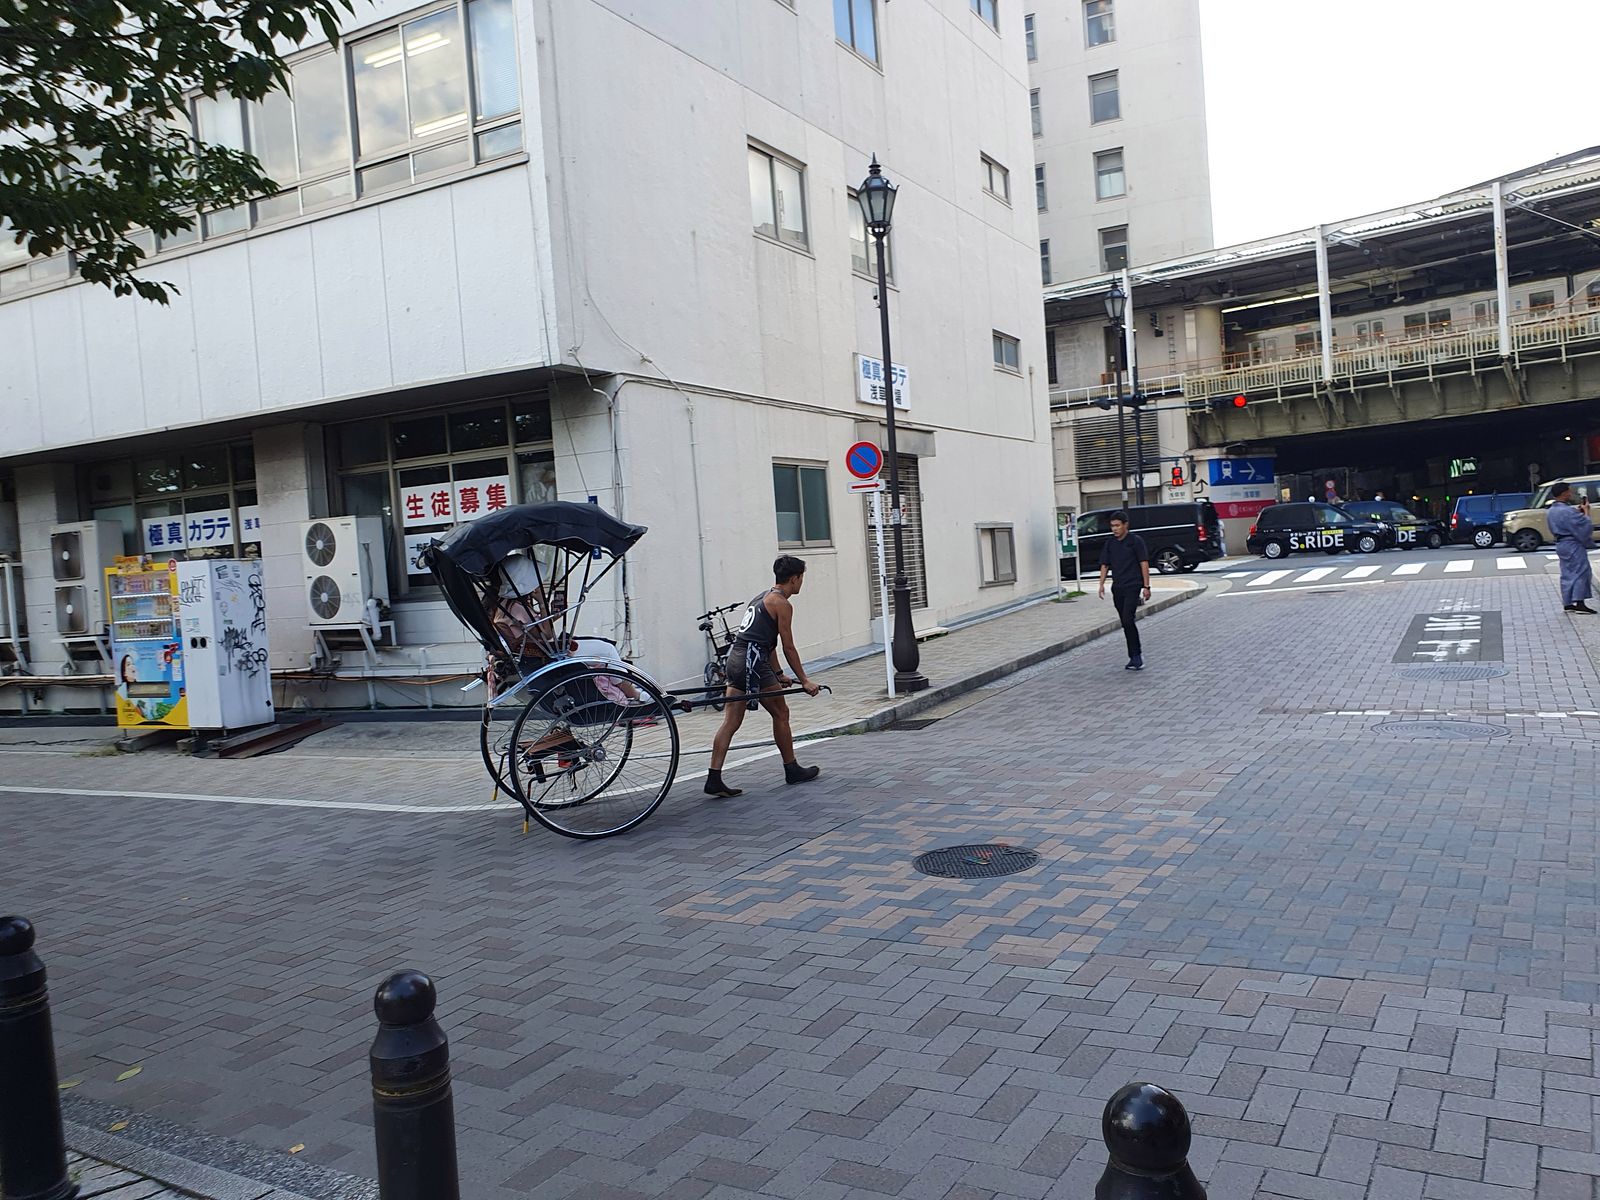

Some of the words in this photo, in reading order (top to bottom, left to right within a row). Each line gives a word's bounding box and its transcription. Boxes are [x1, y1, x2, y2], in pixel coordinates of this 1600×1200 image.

[862, 358, 906, 386] 極真ラテ
[870, 384, 902, 405] 浅草場
[406, 483, 507, 519] 生徒募集
[148, 517, 231, 546] 極真カラテ
[1289, 533, 1345, 550] S.RIDE
[1396, 530, 1417, 543] DE
